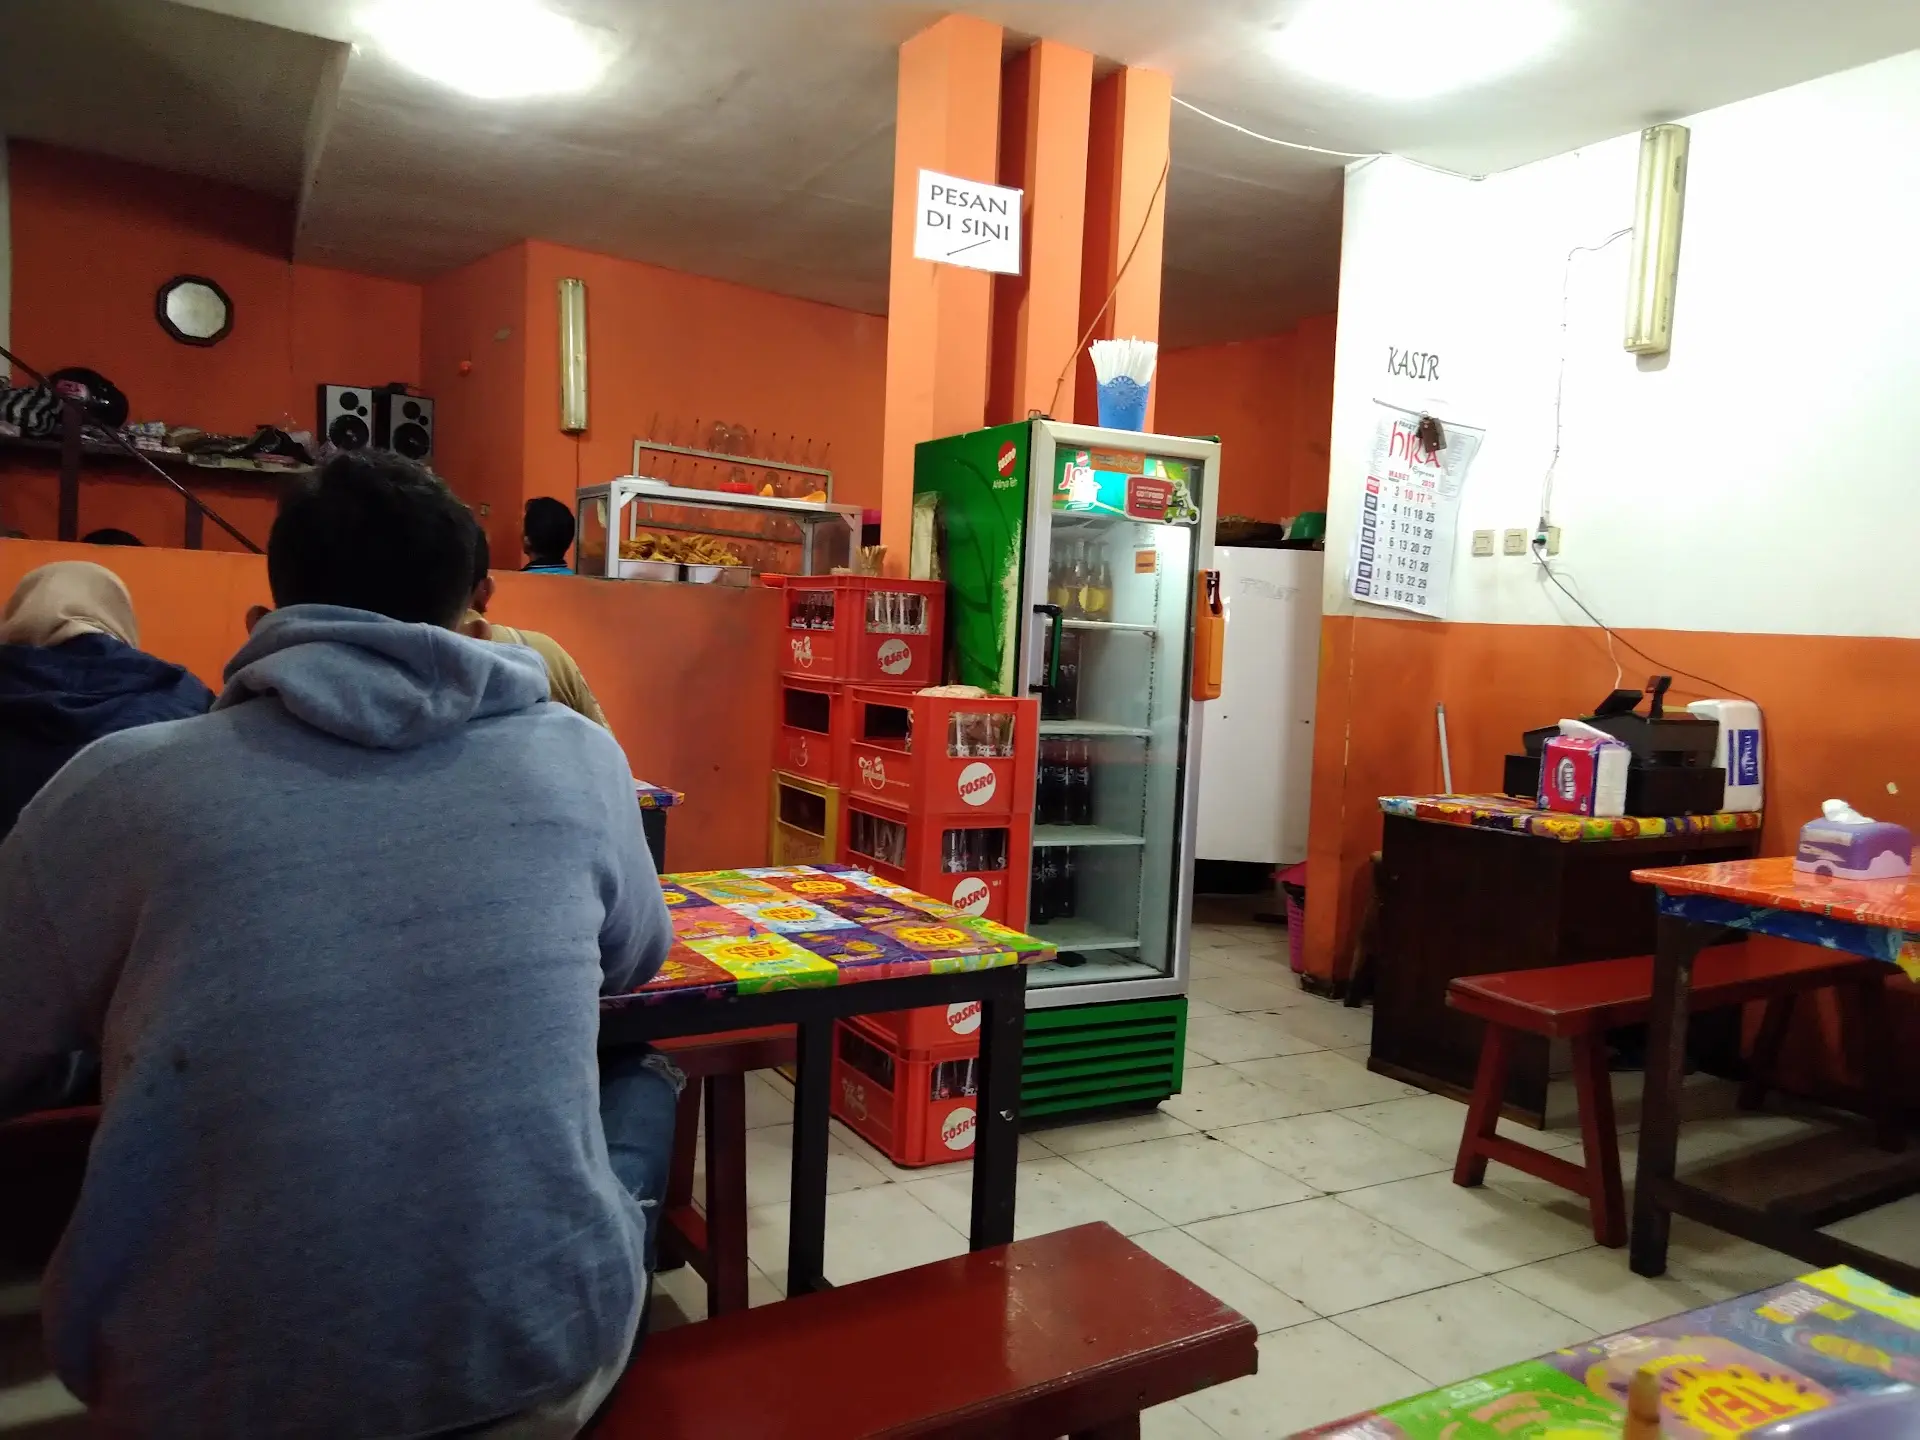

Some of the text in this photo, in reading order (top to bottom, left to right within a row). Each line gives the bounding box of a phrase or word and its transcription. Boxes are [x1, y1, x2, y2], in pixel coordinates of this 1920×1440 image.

[930, 184, 1007, 216] PESAN
[926, 209, 1009, 241] DI SINI
[1387, 346, 1440, 382] KASIR
[1404, 489, 1413, 501] 10
[1416, 493, 1425, 503] 17
[1403, 506, 1411, 517] 11
[1414, 509, 1423, 520] 18
[1425, 512, 1435, 523] 25
[1401, 523, 1410, 534] 12
[1412, 526, 1421, 537] 19
[1424, 528, 1433, 540] 26
[1399, 540, 1408, 551] 13
[1410, 542, 1420, 553] 20
[1422, 545, 1431, 556] 27
[1397, 556, 1406, 567] 14
[1408, 559, 1418, 570] 21
[1420, 561, 1429, 573] 28
[1395, 573, 1404, 584] 15
[1406, 575, 1416, 587] 22
[1417, 578, 1427, 589] 29
[1394, 590, 1403, 601] 16
[1405, 592, 1414, 603] 23
[878, 647, 910, 668] SOSRO
[960, 772, 994, 798] SOSRO
[953, 886, 988, 909] SOSRO
[949, 1000, 981, 1028] SOSRO
[943, 1115, 976, 1142] SOSRO
[1697, 1384, 1800, 1432] TEA
